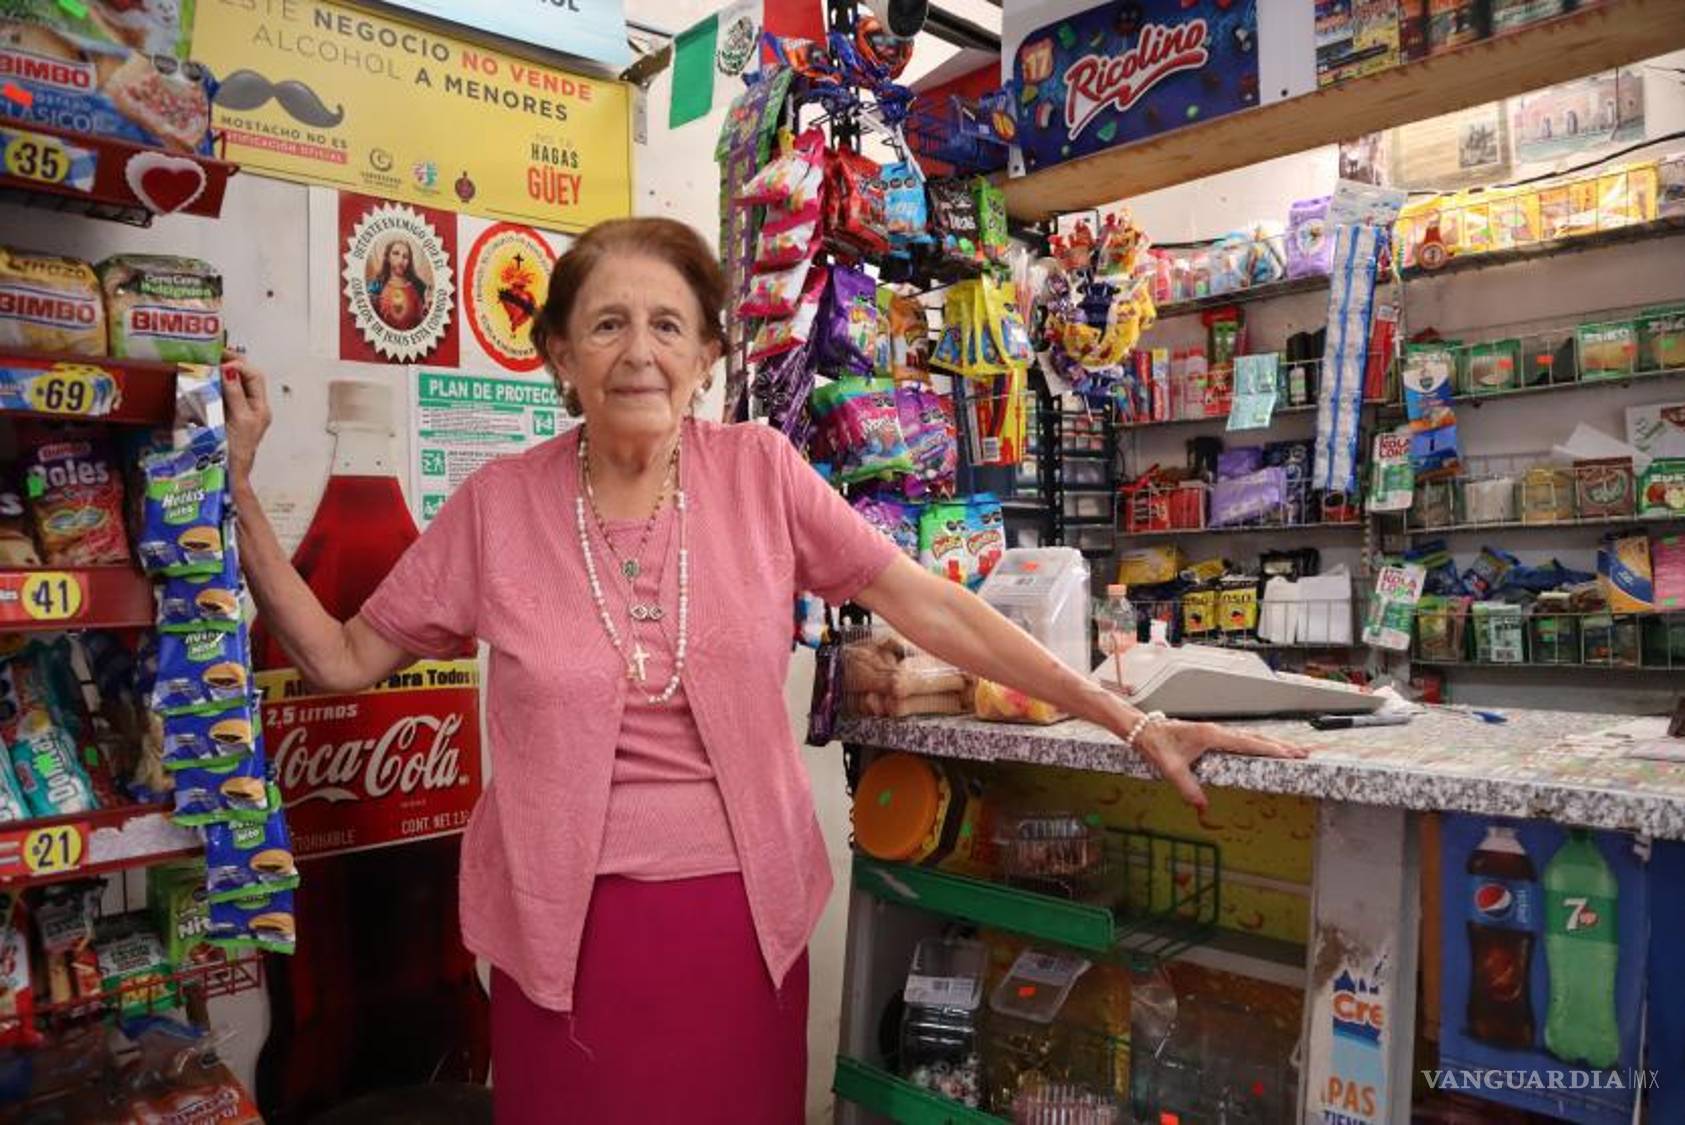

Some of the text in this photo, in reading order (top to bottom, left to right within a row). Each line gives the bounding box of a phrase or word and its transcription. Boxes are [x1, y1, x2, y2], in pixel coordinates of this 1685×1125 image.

[219, 0, 593, 101] TE NEGOCIO NO VENDE
[0, 55, 90, 88] BIMBO
[253, 24, 568, 121] ALCOHOL A MENORES
[1064, 19, 1207, 128] Ricolino
[222, 116, 299, 139] MOSTACHO
[307, 133, 326, 144] NO
[531, 143, 578, 169] HAGAS
[528, 165, 582, 206] GÜEY
[0, 292, 96, 324] BIMBO
[132, 311, 219, 335] BIMBO
[429, 379, 557, 405] PLAN DE PROTECC
[372, 668, 471, 690] ara Todos
[301, 704, 358, 723] LITROS
[275, 714, 464, 797] Coca-Cola
